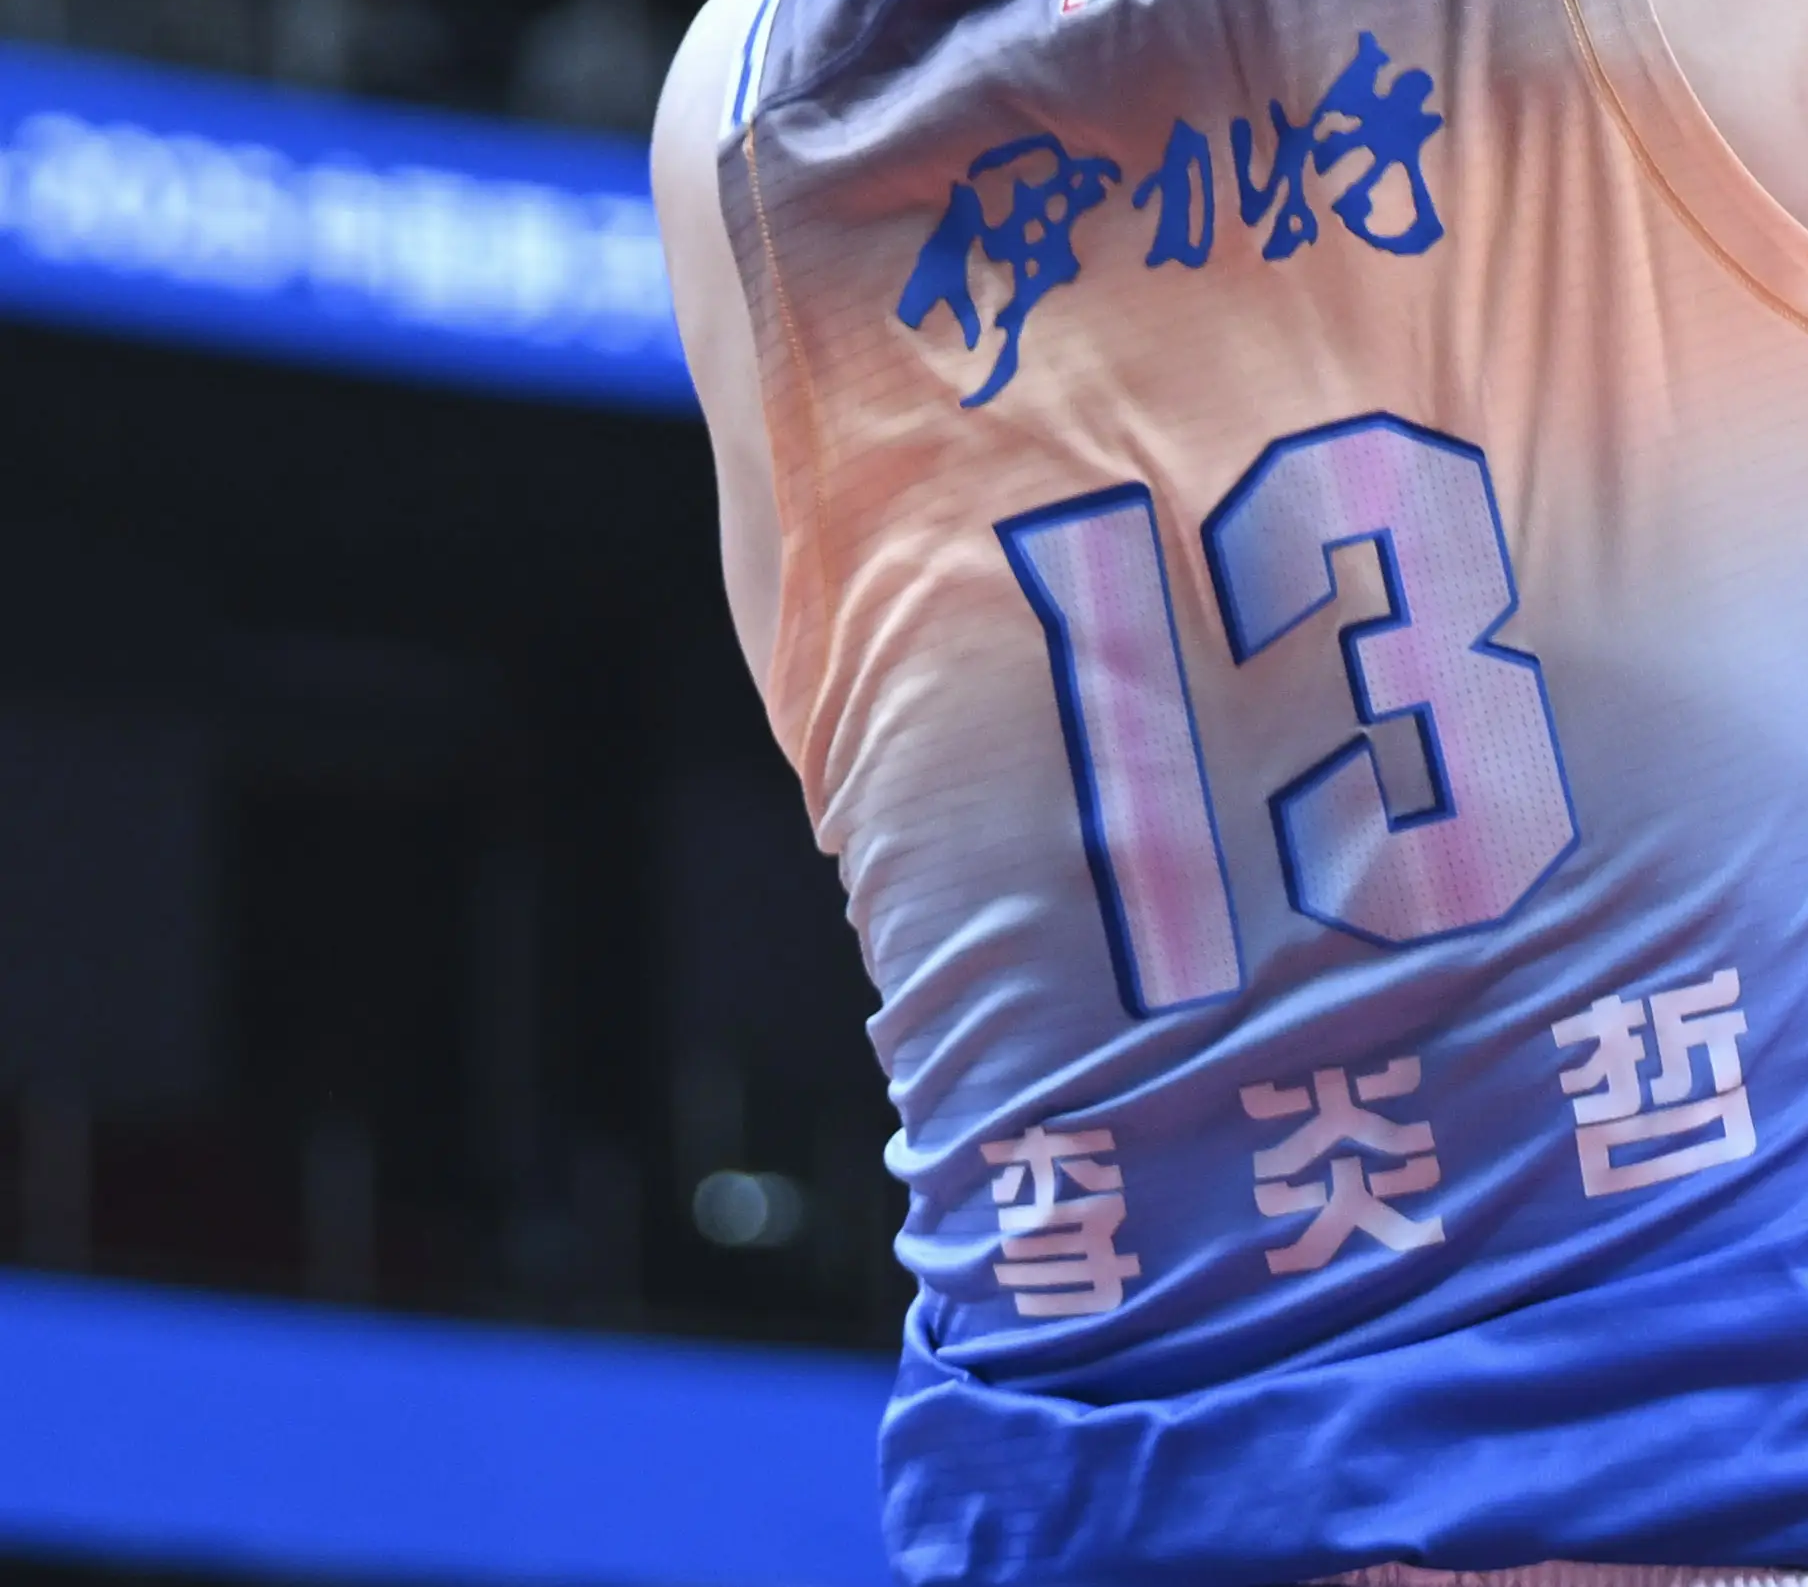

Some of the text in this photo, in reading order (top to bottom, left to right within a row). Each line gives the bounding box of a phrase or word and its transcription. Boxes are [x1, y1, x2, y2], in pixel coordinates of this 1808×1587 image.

[993, 410, 1580, 1020] 13
[979, 967, 1757, 1318] 李炎哲
